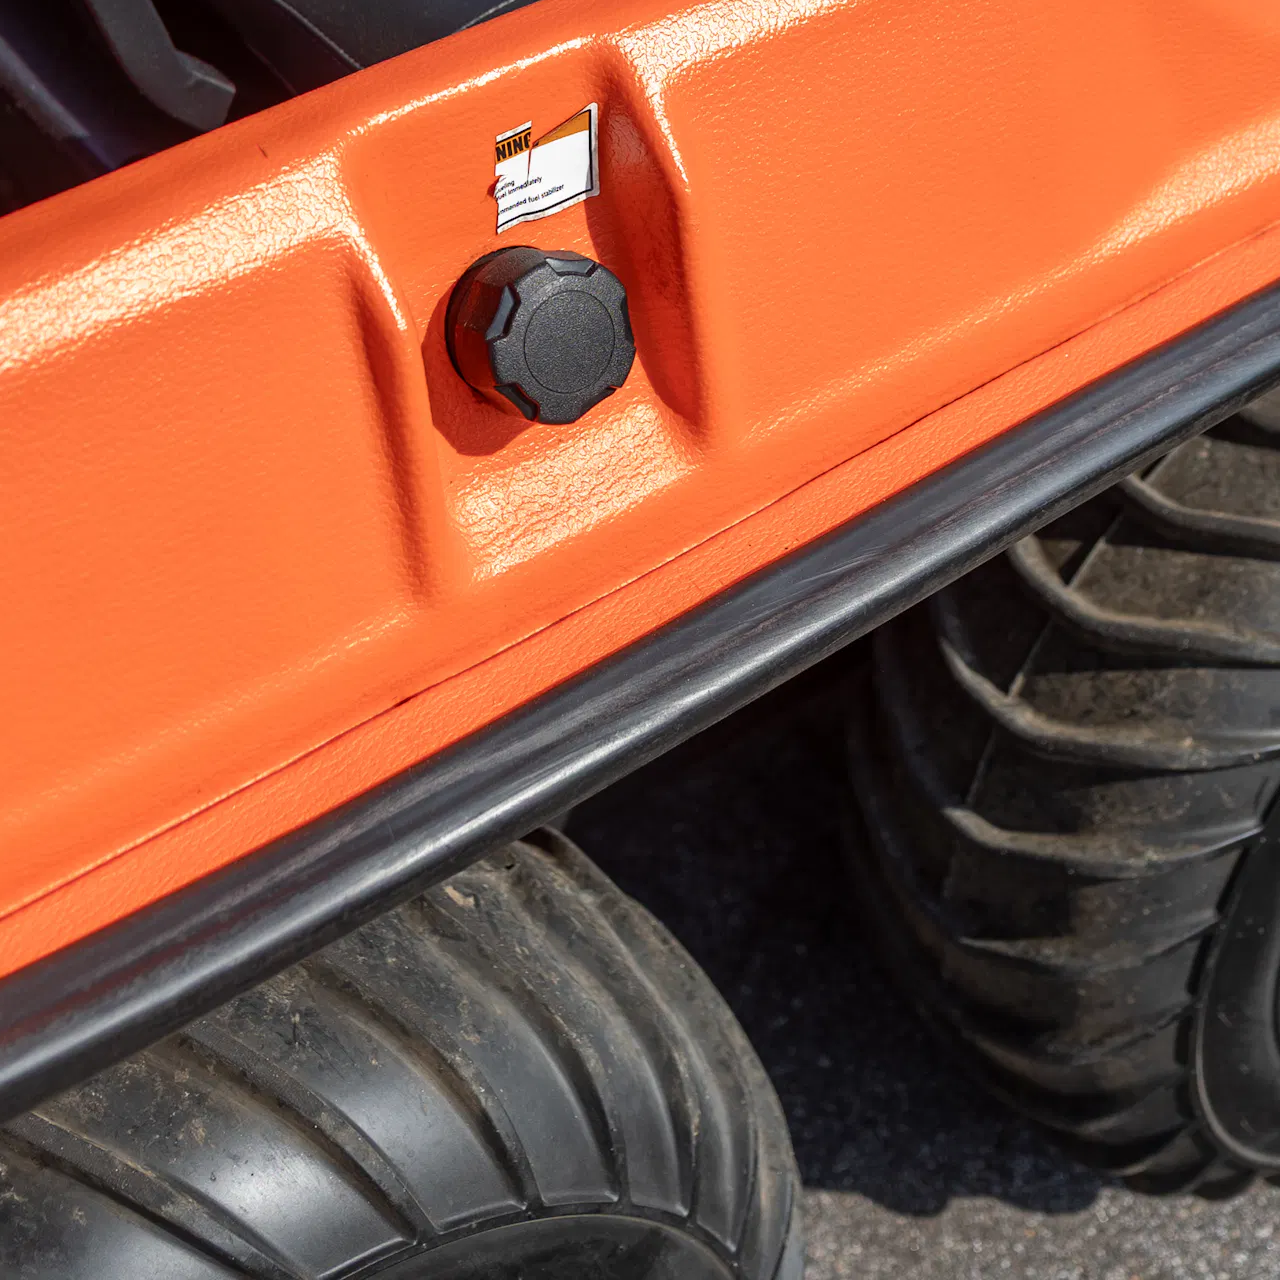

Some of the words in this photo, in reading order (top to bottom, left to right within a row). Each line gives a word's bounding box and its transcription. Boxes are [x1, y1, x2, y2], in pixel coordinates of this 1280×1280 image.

[508, 176, 542, 194] immediately
[528, 194, 540, 203] fuel
[541, 184, 564, 199] stabilizer
